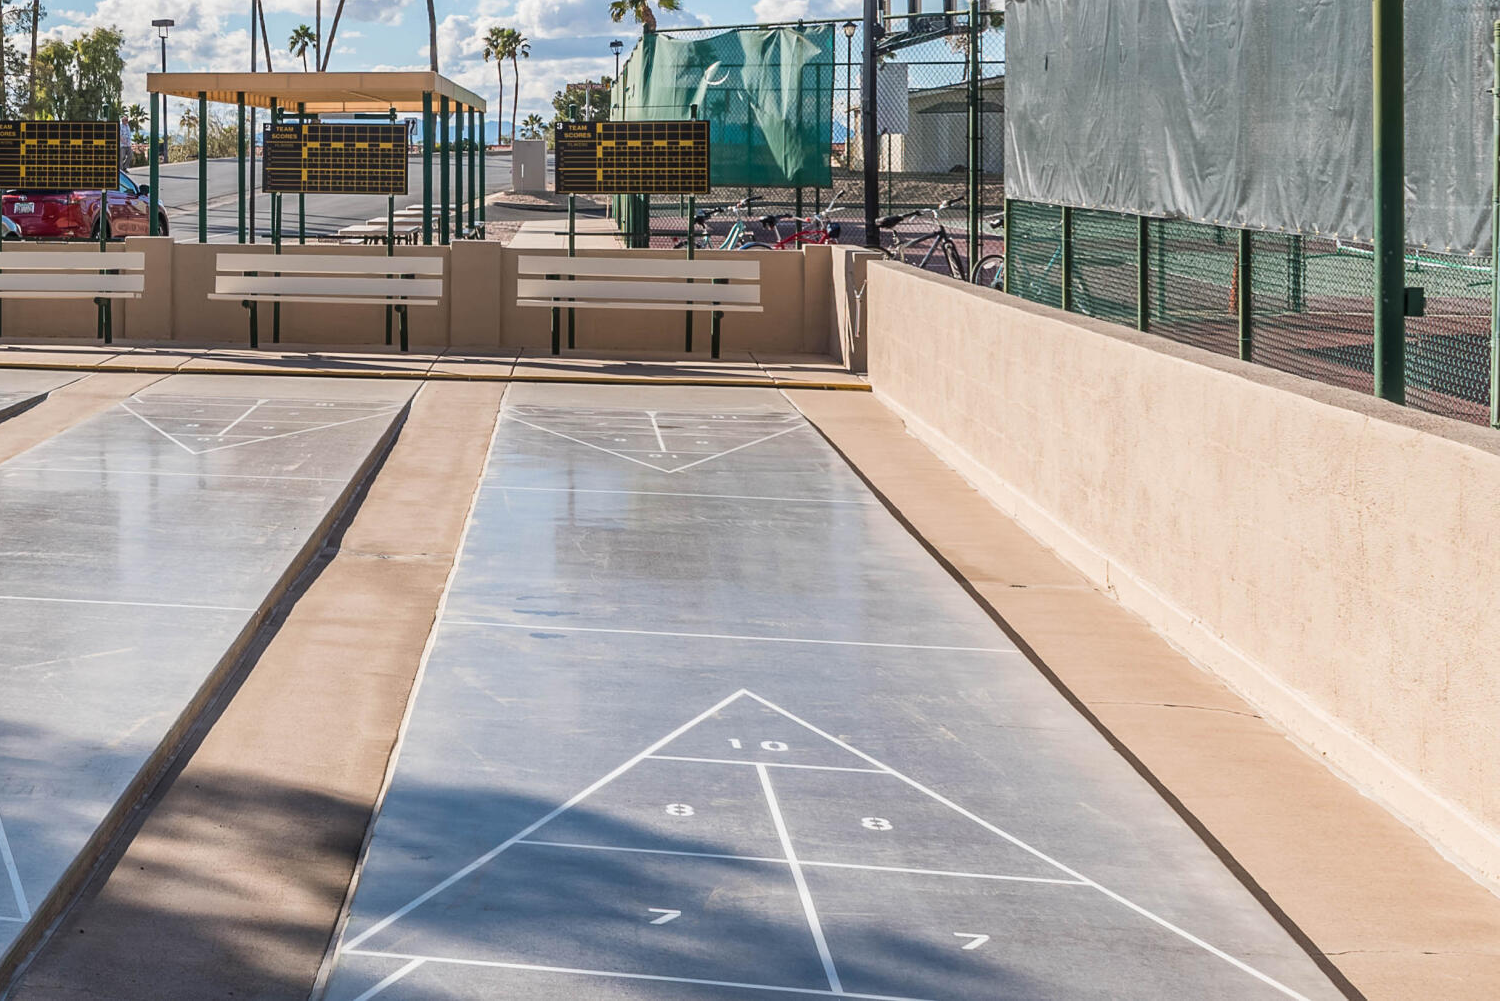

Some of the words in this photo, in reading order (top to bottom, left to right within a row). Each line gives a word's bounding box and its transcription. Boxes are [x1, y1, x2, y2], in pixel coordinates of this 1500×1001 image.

[556, 122, 563, 130] 3
[727, 738, 789, 752] 10
[665, 802, 695, 817] 8
[860, 816, 894, 832] 8
[648, 907, 682, 925] 7
[953, 931, 990, 950] 7
